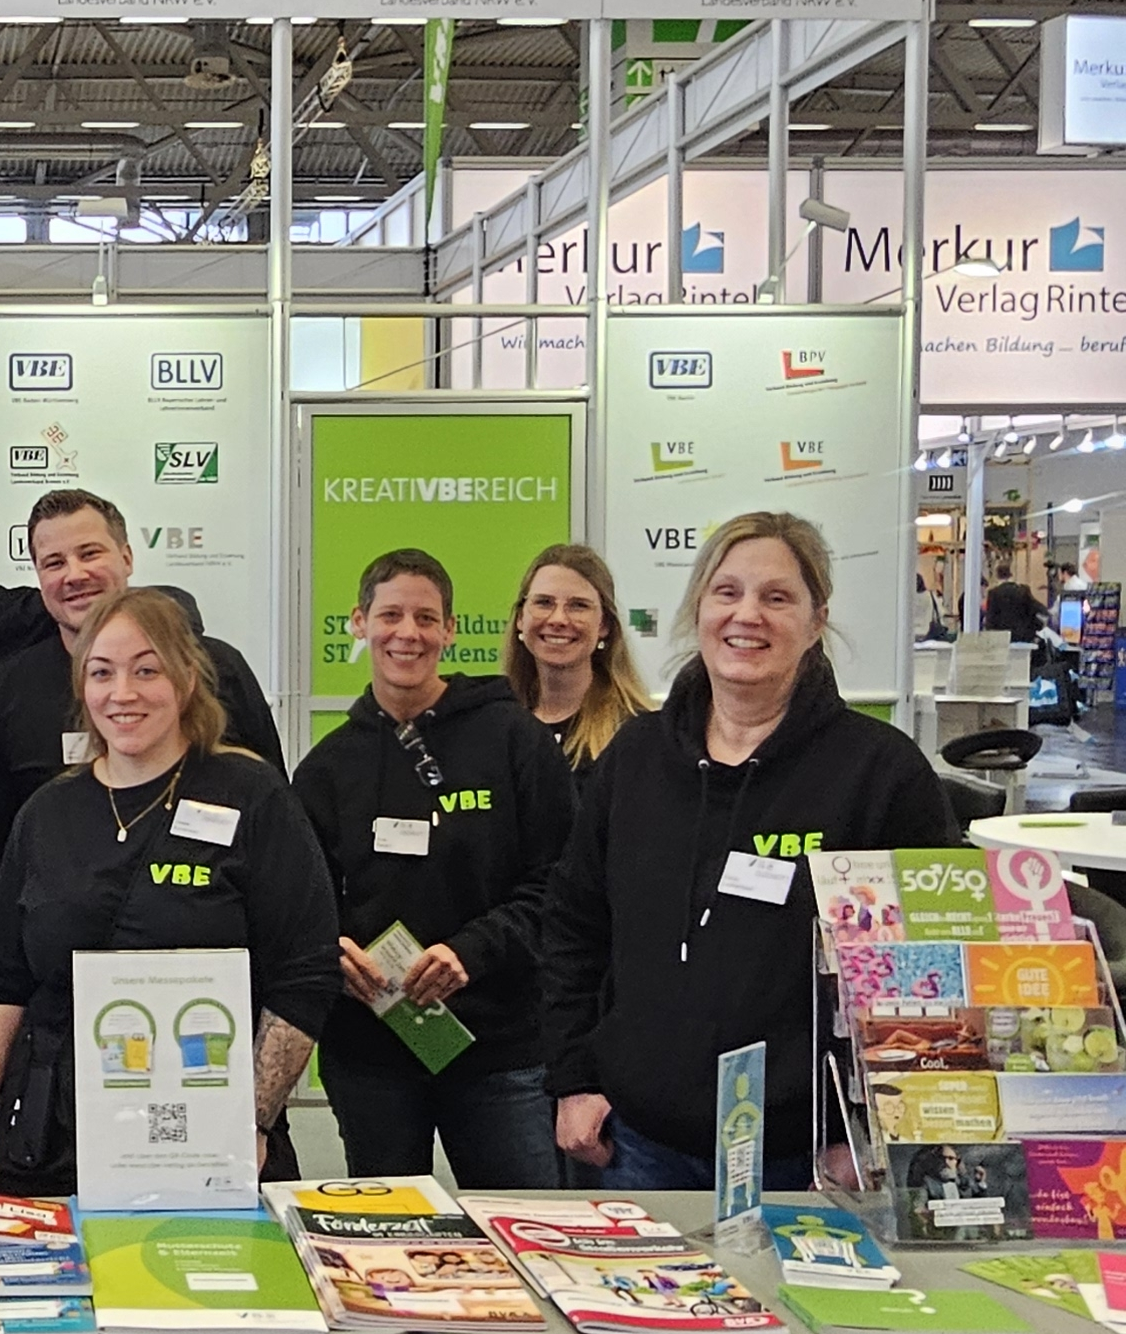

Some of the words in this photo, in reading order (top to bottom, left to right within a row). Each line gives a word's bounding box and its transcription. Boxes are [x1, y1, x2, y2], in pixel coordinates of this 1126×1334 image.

[565, 284, 663, 305] Vrlag
[936, 283, 1039, 321] Verlag
[500, 336, 526, 350] Wi
[538, 335, 586, 351] mach
[921, 335, 978, 353] achen
[986, 334, 1055, 357] Bildung
[799, 350, 826, 363] BPV
[15, 359, 67, 378] VBE
[157, 359, 218, 384] BLLV
[656, 357, 707, 377] VBE
[14, 450, 46, 462] VBE
[667, 441, 695, 454] VBE
[797, 440, 824, 453] VBE
[169, 451, 211, 468] SLV
[324, 477, 558, 503] KREATIVBEREICH
[140, 527, 204, 549] VBE
[645, 527, 697, 549] VBE
[439, 790, 492, 813] VBE
[753, 832, 824, 857] VBE
[150, 863, 212, 886] VBE
[1016, 968, 1049, 982] GUTE
[1017, 982, 1051, 997] IDEE
